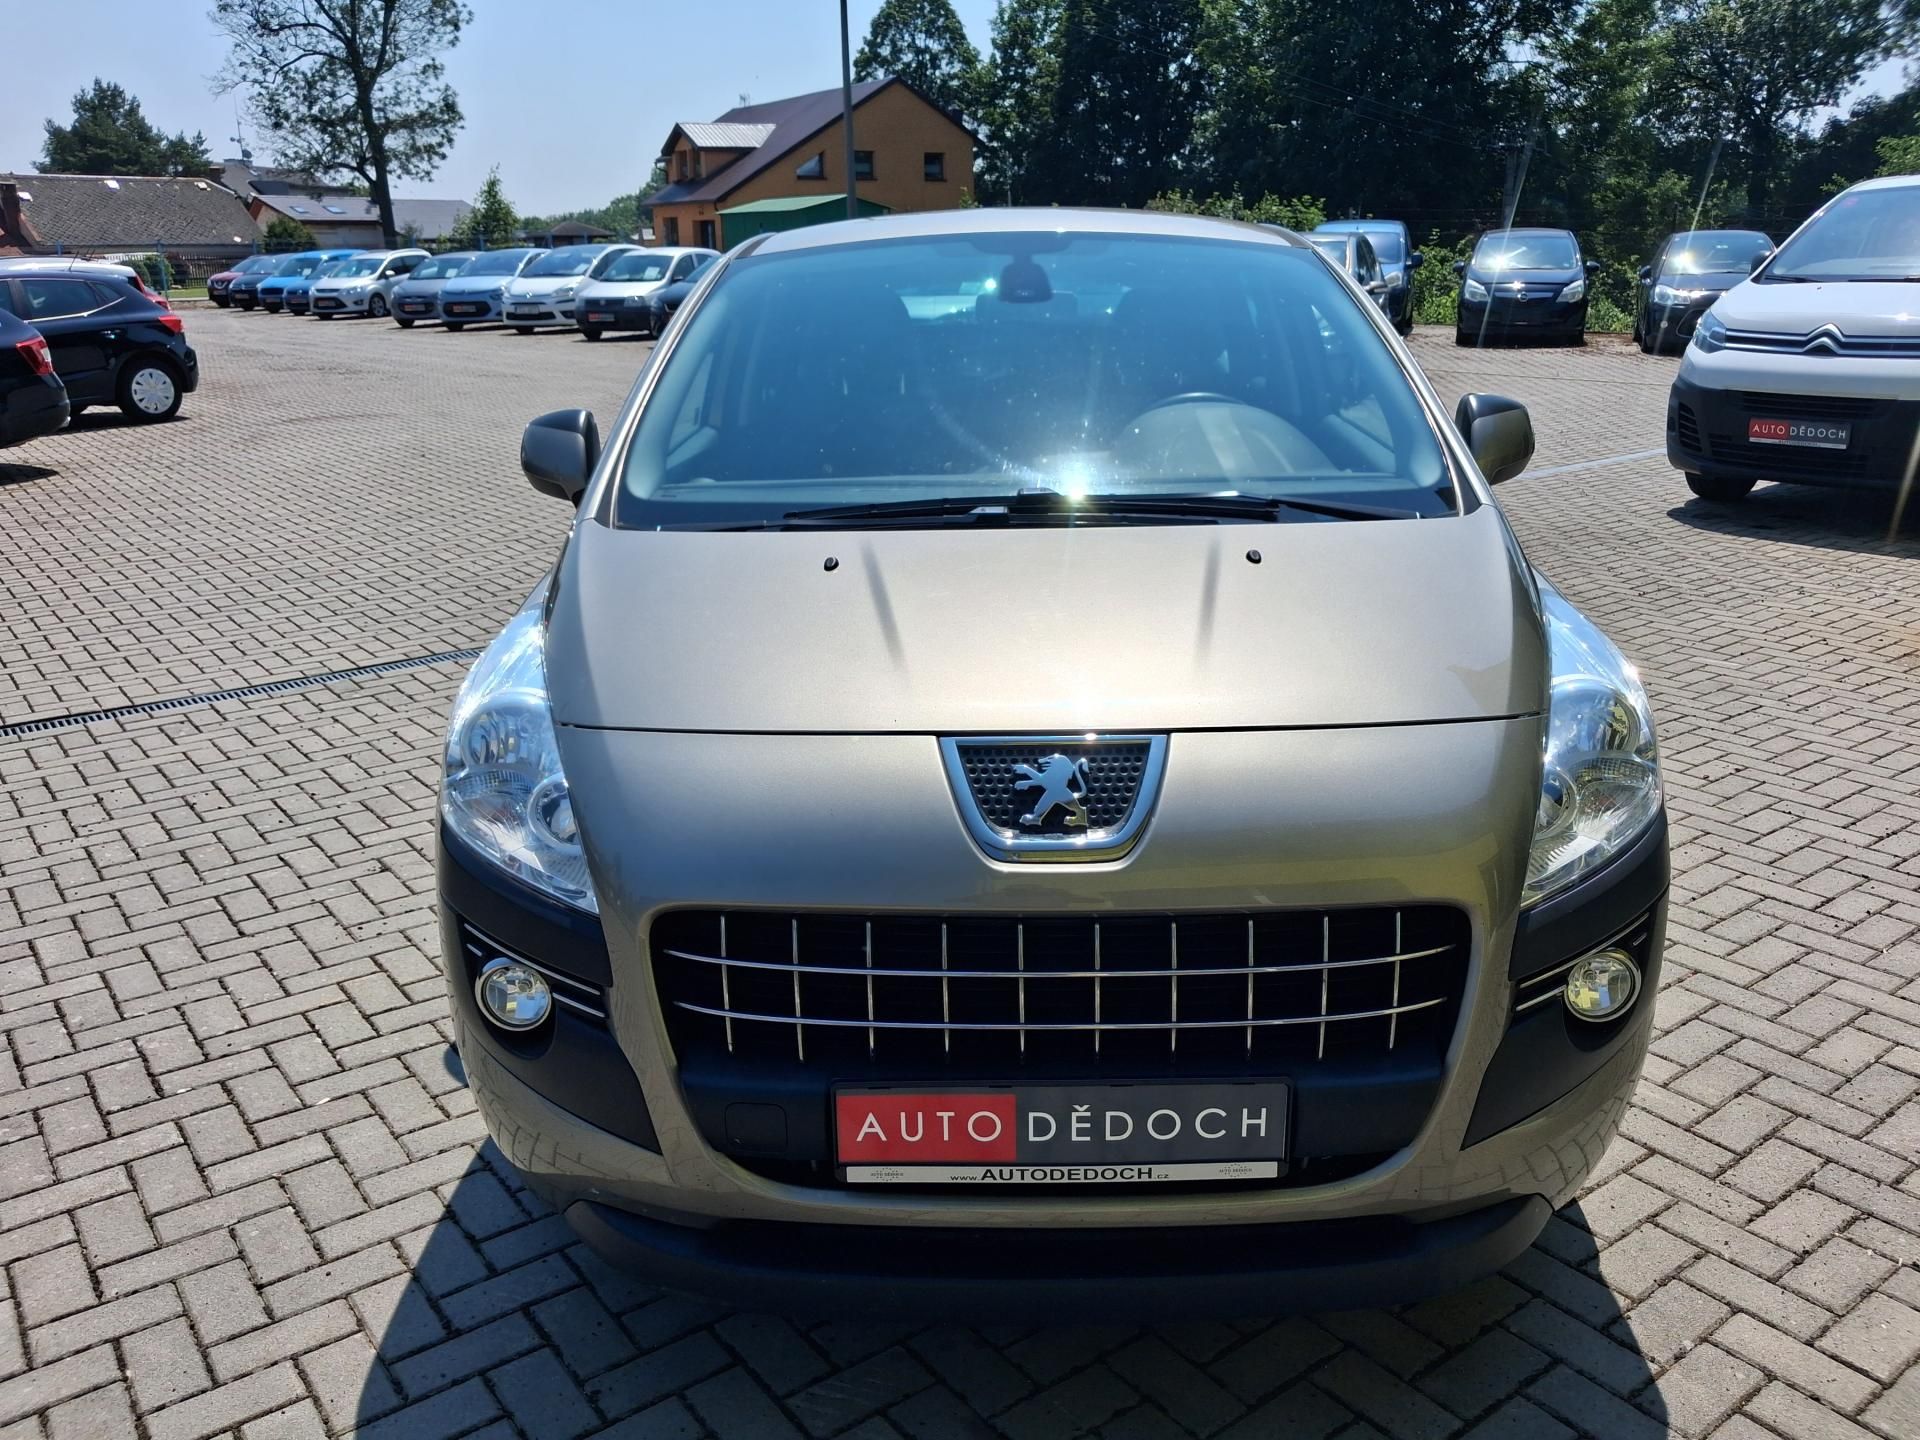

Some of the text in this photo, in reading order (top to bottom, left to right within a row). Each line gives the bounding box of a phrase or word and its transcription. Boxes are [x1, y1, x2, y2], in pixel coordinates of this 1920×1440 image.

[1752, 423, 1846, 439] AUTO DĚDOCH
[856, 1105, 1267, 1142] AUTO DĚDOCH
